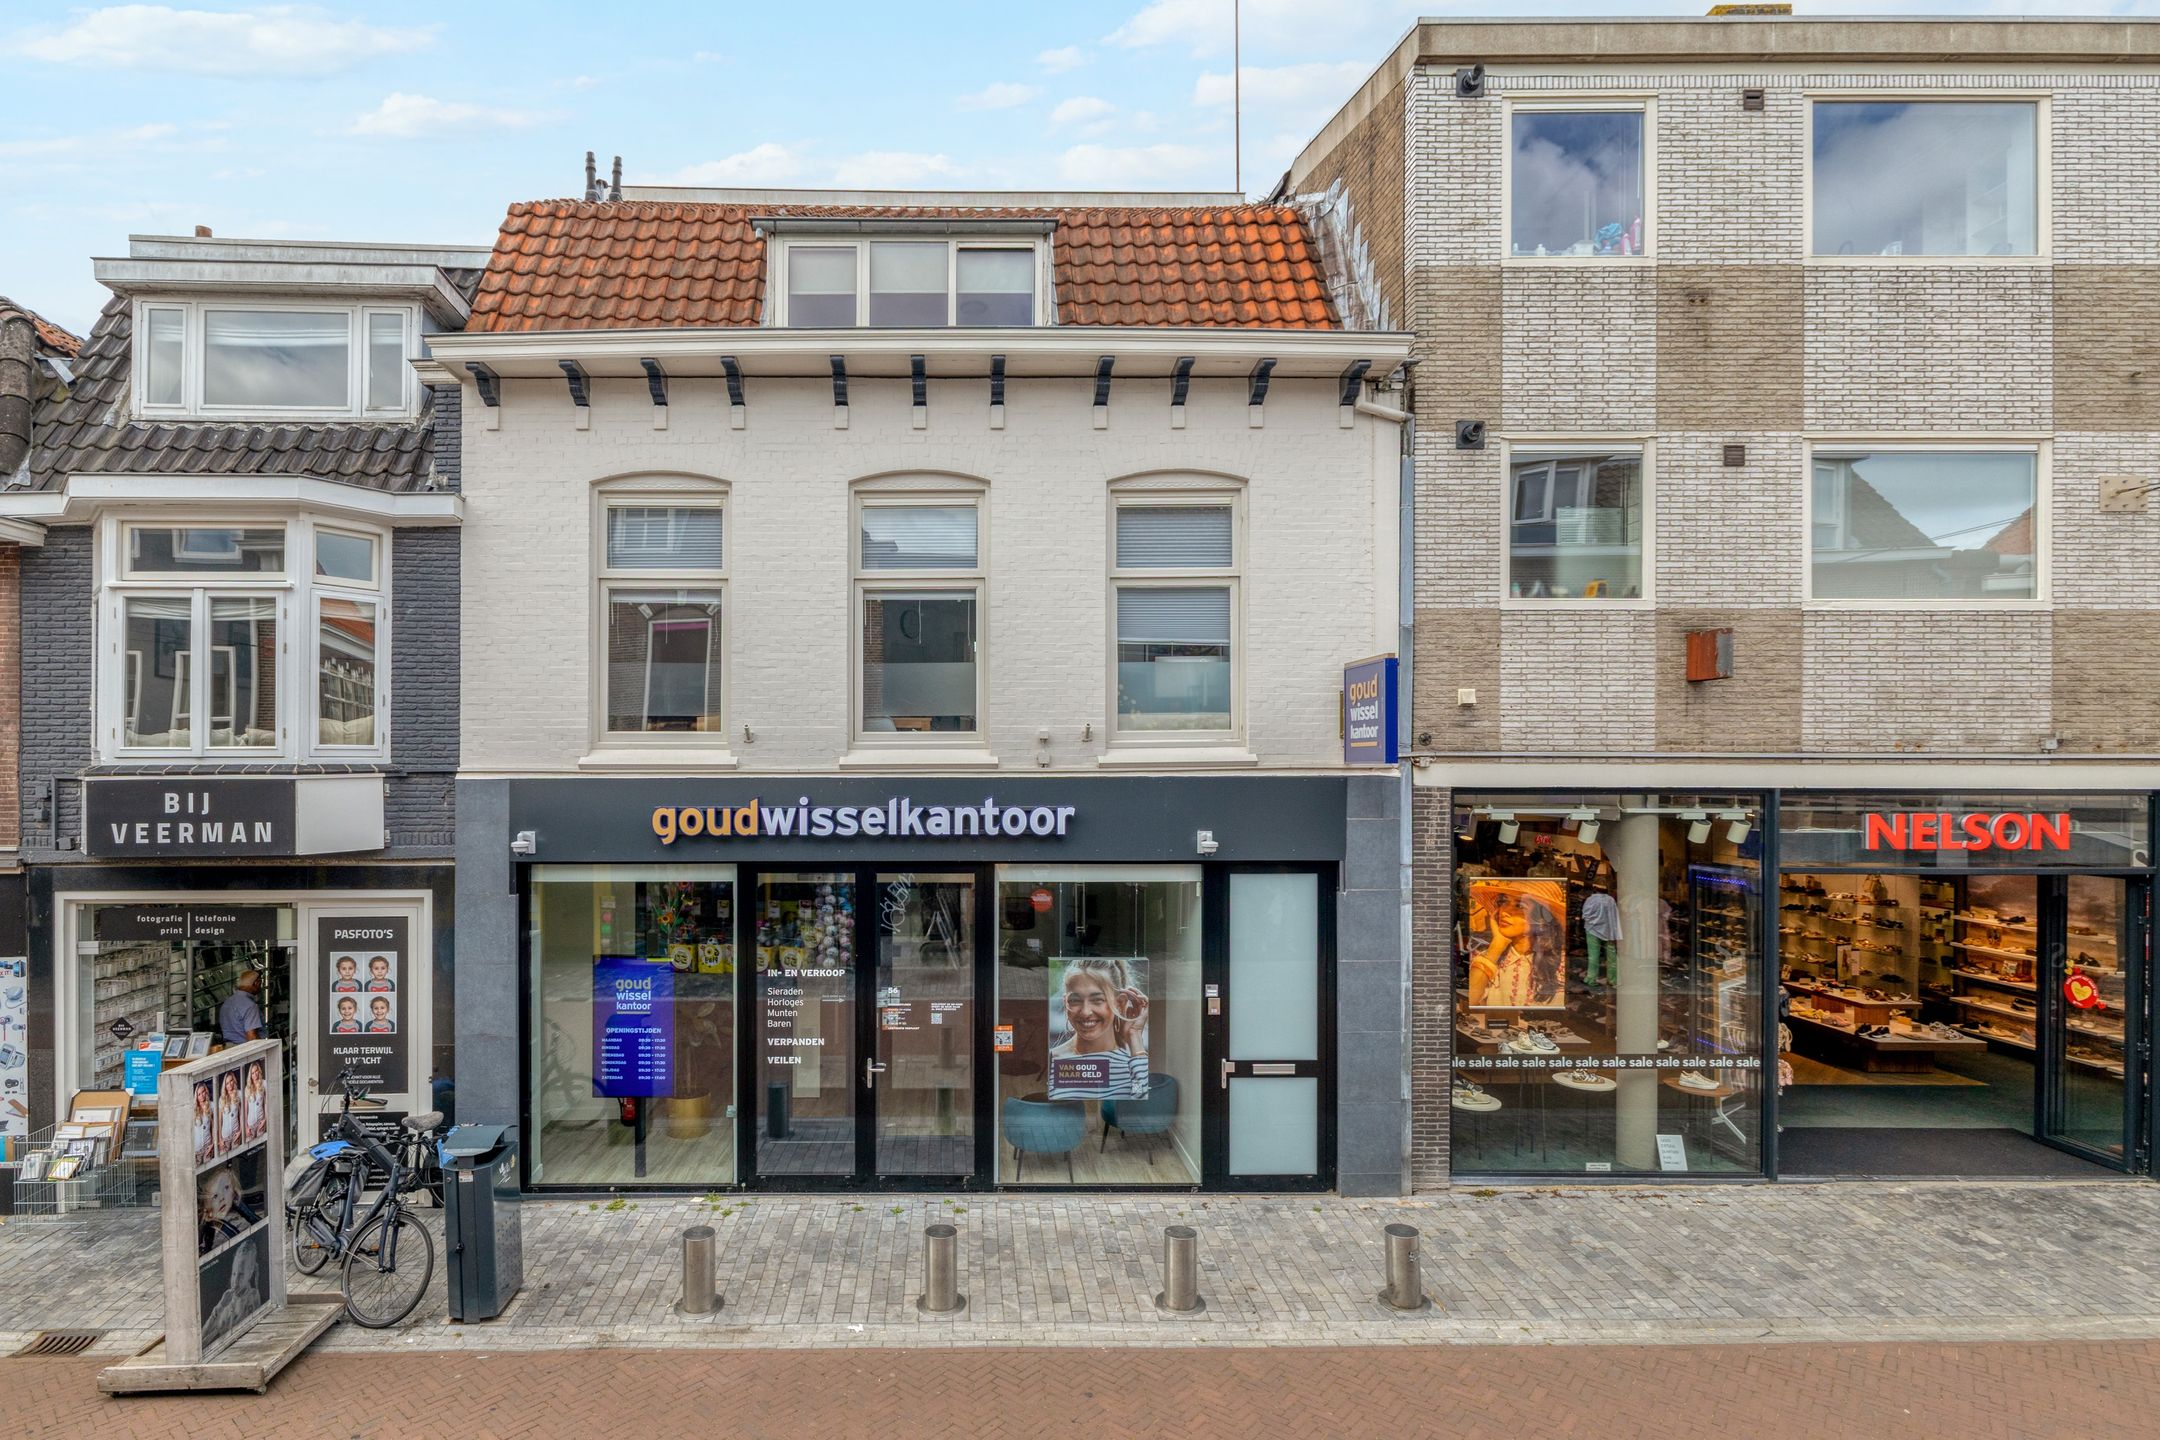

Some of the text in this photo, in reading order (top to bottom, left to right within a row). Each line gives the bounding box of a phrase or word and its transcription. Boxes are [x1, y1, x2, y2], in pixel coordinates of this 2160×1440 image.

[1350, 673, 1378, 705] goud
[1350, 700, 1378, 721] wissel
[1350, 723, 1378, 739] kantoor
[164, 792, 210, 815] BIJ
[651, 796, 1076, 846] goudwisselkantoor
[111, 821, 272, 844] VEERMAN
[1865, 813, 2071, 850] NELSON
[137, 914, 183, 924] fotografie
[195, 914, 236, 922] telefonie
[160, 927, 183, 935] print
[195, 927, 225, 935] design
[334, 929, 394, 939] PASFOTO'S
[767, 969, 846, 977] IN- EN VERKOOP
[616, 977, 651, 991] goud
[616, 990, 651, 1000] wissel
[767, 987, 803, 995] Sieraden
[616, 1001, 652, 1010] kantoor
[767, 998, 804, 1007] Horloges
[767, 1009, 798, 1017] Munten
[767, 1038, 825, 1046] VERPANDEN
[333, 1047, 359, 1055] KLAAR
[767, 1056, 802, 1064] VEILEN
[1468, 1056, 1492, 1067] sale
[1495, 1056, 1519, 1067] sale
[1522, 1056, 1546, 1067] sale
[1549, 1056, 1573, 1067] sale
[1576, 1056, 1600, 1067] sale
[1602, 1056, 1626, 1067] sale
[1629, 1056, 1653, 1067] sale
[1656, 1056, 1680, 1067] sale
[1682, 1056, 1706, 1067] sale
[1709, 1056, 1733, 1067] sale
[1736, 1056, 1760, 1067] sale
